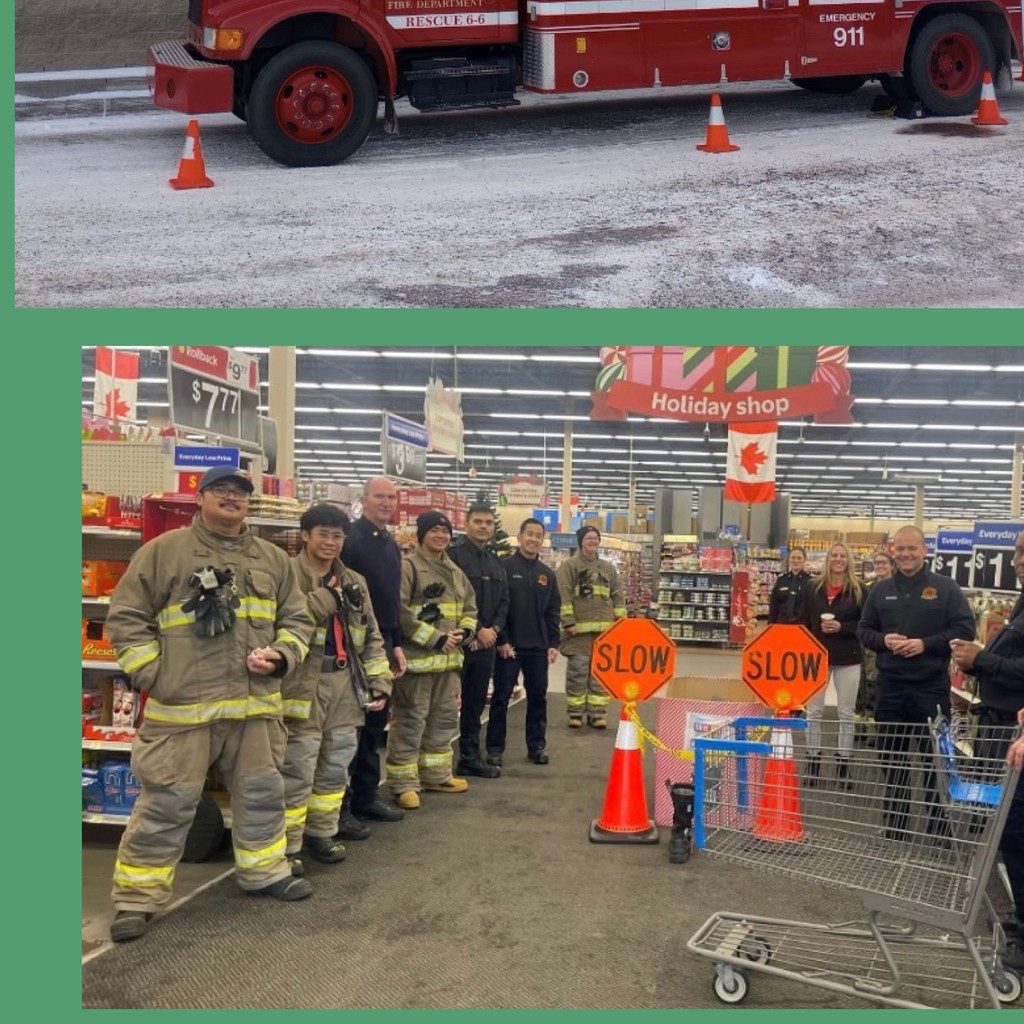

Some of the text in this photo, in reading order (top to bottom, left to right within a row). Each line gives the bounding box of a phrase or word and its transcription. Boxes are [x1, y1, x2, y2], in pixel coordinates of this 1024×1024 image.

[388, 0, 413, 10] FIRE
[406, 14, 485, 27] RESCUE 6-6
[819, 13, 875, 23] EMERGENCY
[833, 27, 864, 47] 911
[186, 346, 218, 366] Rollback
[651, 392, 790, 419] Holiday shop
[941, 537, 973, 547] Everyday
[979, 529, 1018, 541] Everyday
[596, 643, 670, 675] SLOW
[746, 651, 821, 682] SLOW
